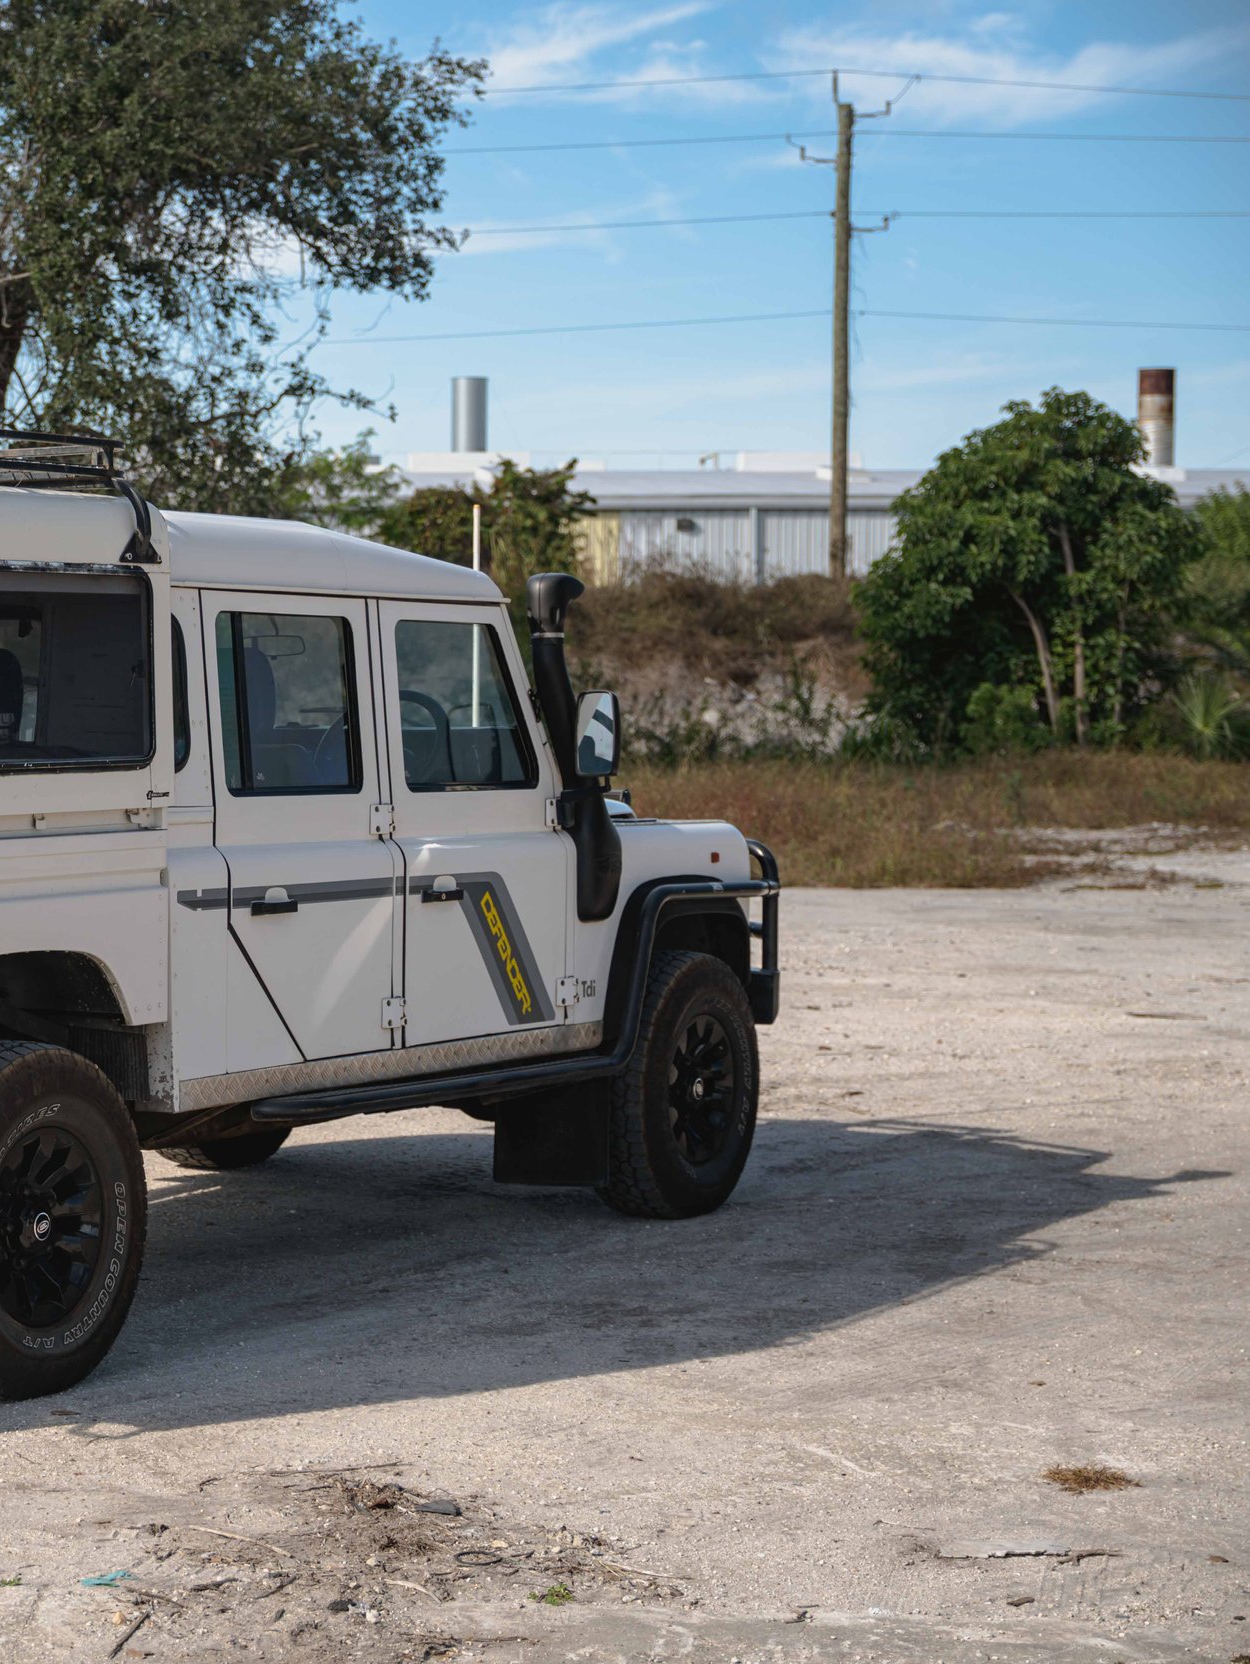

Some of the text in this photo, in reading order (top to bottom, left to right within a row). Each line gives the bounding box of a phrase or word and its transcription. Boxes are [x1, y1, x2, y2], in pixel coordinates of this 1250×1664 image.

[480, 890, 532, 1016] DEFENDER
[581, 980, 596, 998] Tdi
[21, 1181, 128, 1349] OPEN COUNTRY A/T
